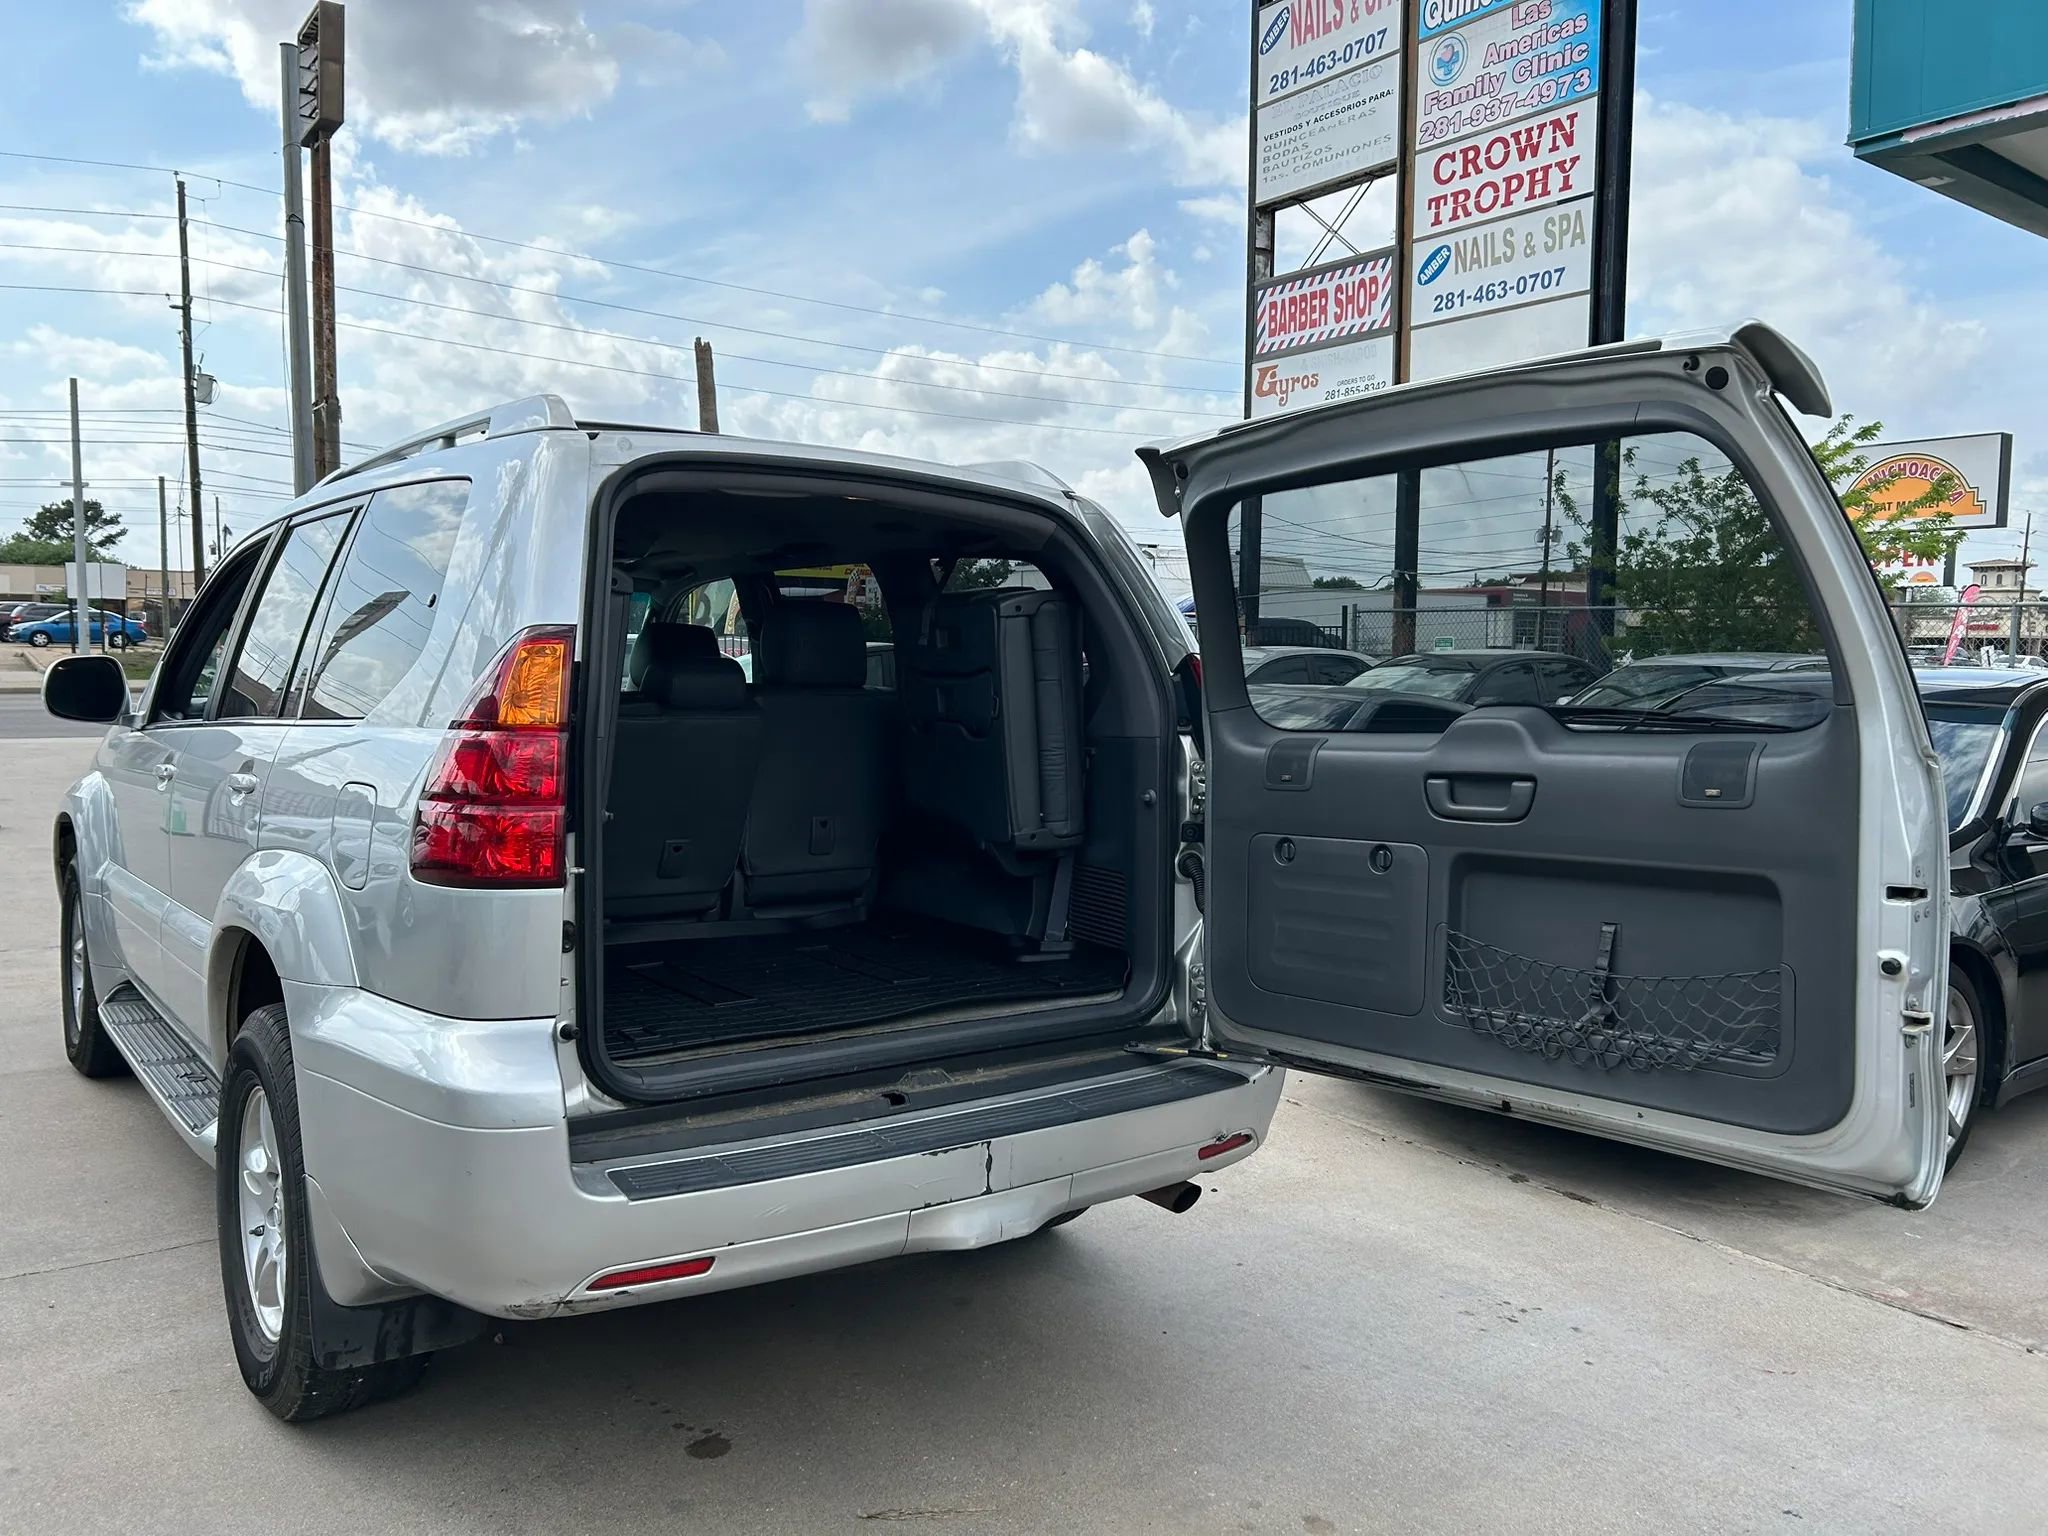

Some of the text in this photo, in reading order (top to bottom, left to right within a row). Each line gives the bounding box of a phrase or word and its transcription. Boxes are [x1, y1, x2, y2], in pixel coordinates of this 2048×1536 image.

[1262, 10, 1289, 52] AMBER
[1290, 0, 1344, 49] NAILS
[1511, 0, 1553, 30] Las
[1269, 28, 1388, 94] 281-463-0707
[1482, 13, 1589, 68] Americas
[1424, 43, 1590, 116] Family Clinic
[1263, 88, 1395, 142] VESTIDOS Y ACCESORIOS PARA:
[1419, 67, 1592, 145] 281-937-4973
[1262, 142, 1309, 164] BODAS
[1262, 144, 1333, 174] BAUTIZOS
[1293, 133, 1392, 174] COMUNIONES
[1433, 112, 1578, 186] CROWN
[1427, 155, 1581, 227] TROPHY
[1419, 247, 1450, 284] AMBER
[1454, 209, 1586, 275] NAILS & SPA
[1267, 275, 1379, 338] BARBER SHOP
[1432, 267, 1566, 313] 281-463-0707
[1254, 364, 1319, 407] Gyros
[1336, 374, 1376, 387] ORDERS TO GO
